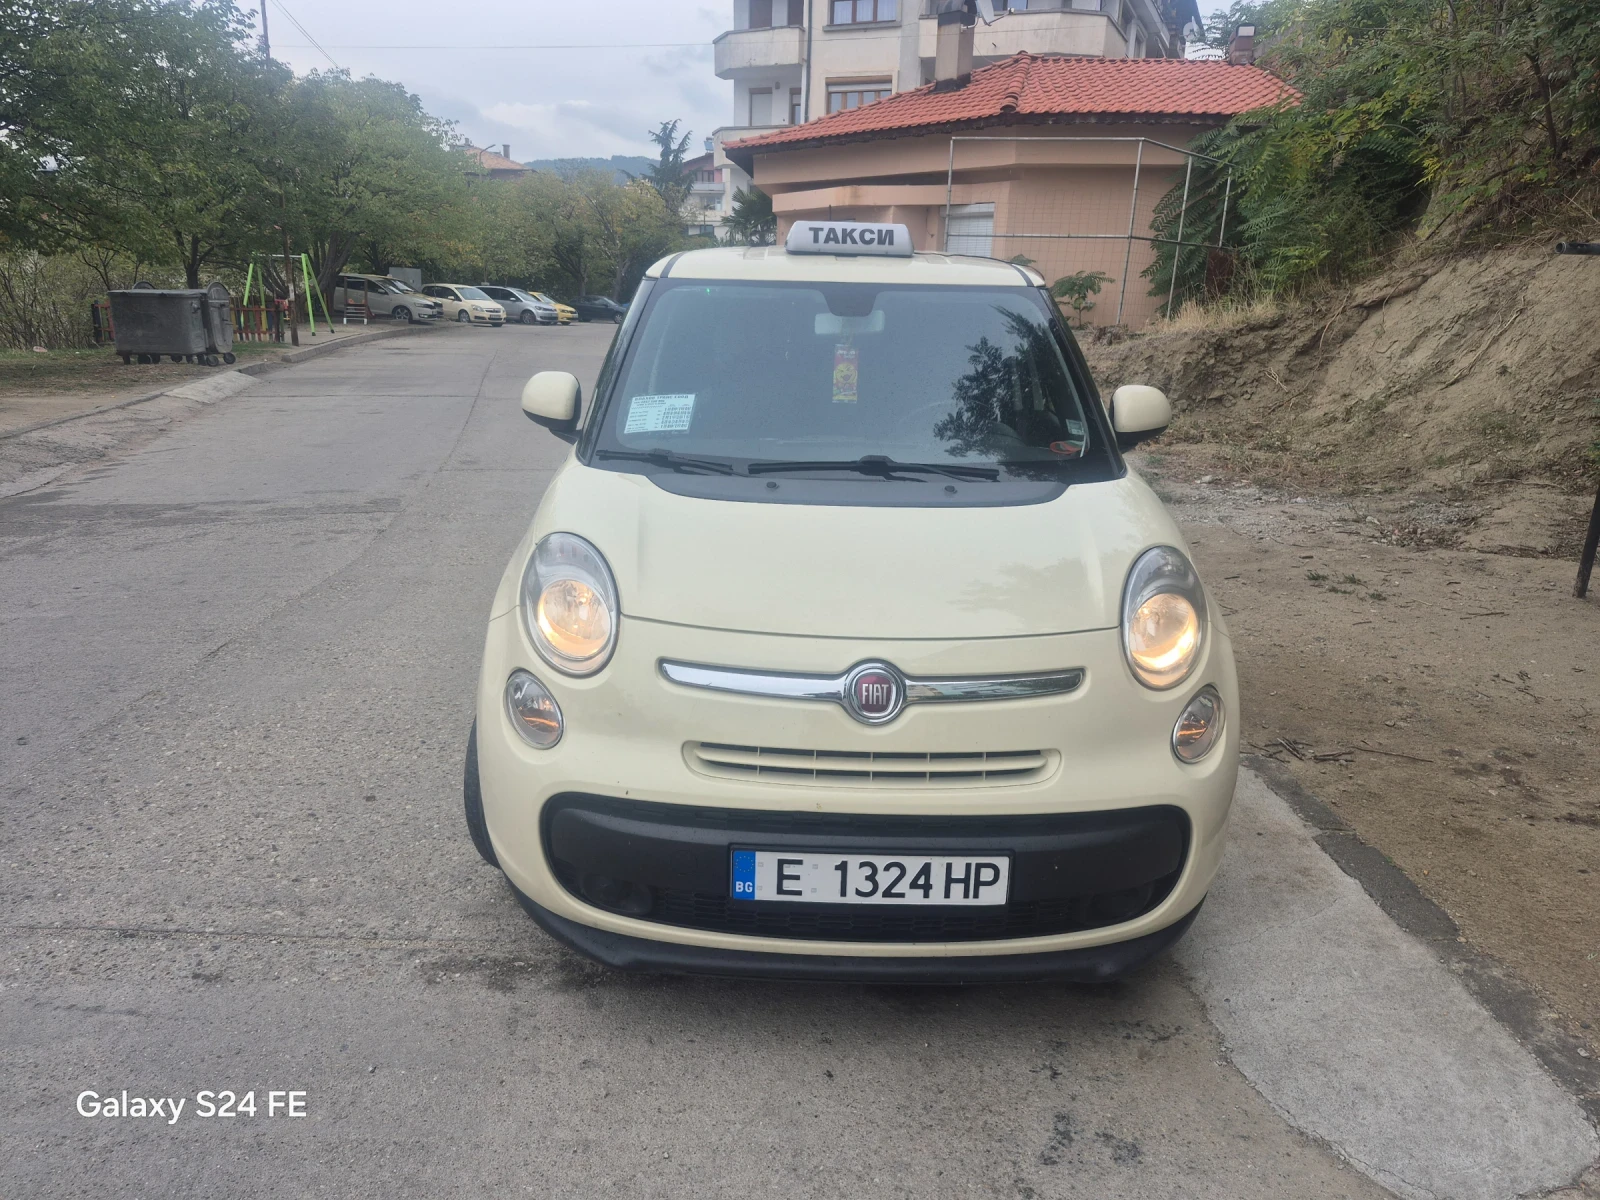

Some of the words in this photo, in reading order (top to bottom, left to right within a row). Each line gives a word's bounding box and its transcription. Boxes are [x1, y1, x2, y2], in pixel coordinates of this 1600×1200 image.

[808, 227, 894, 246] ТАКСИ
[862, 683, 889, 705] FIAT
[735, 881, 753, 893] BG
[776, 858, 804, 897] E
